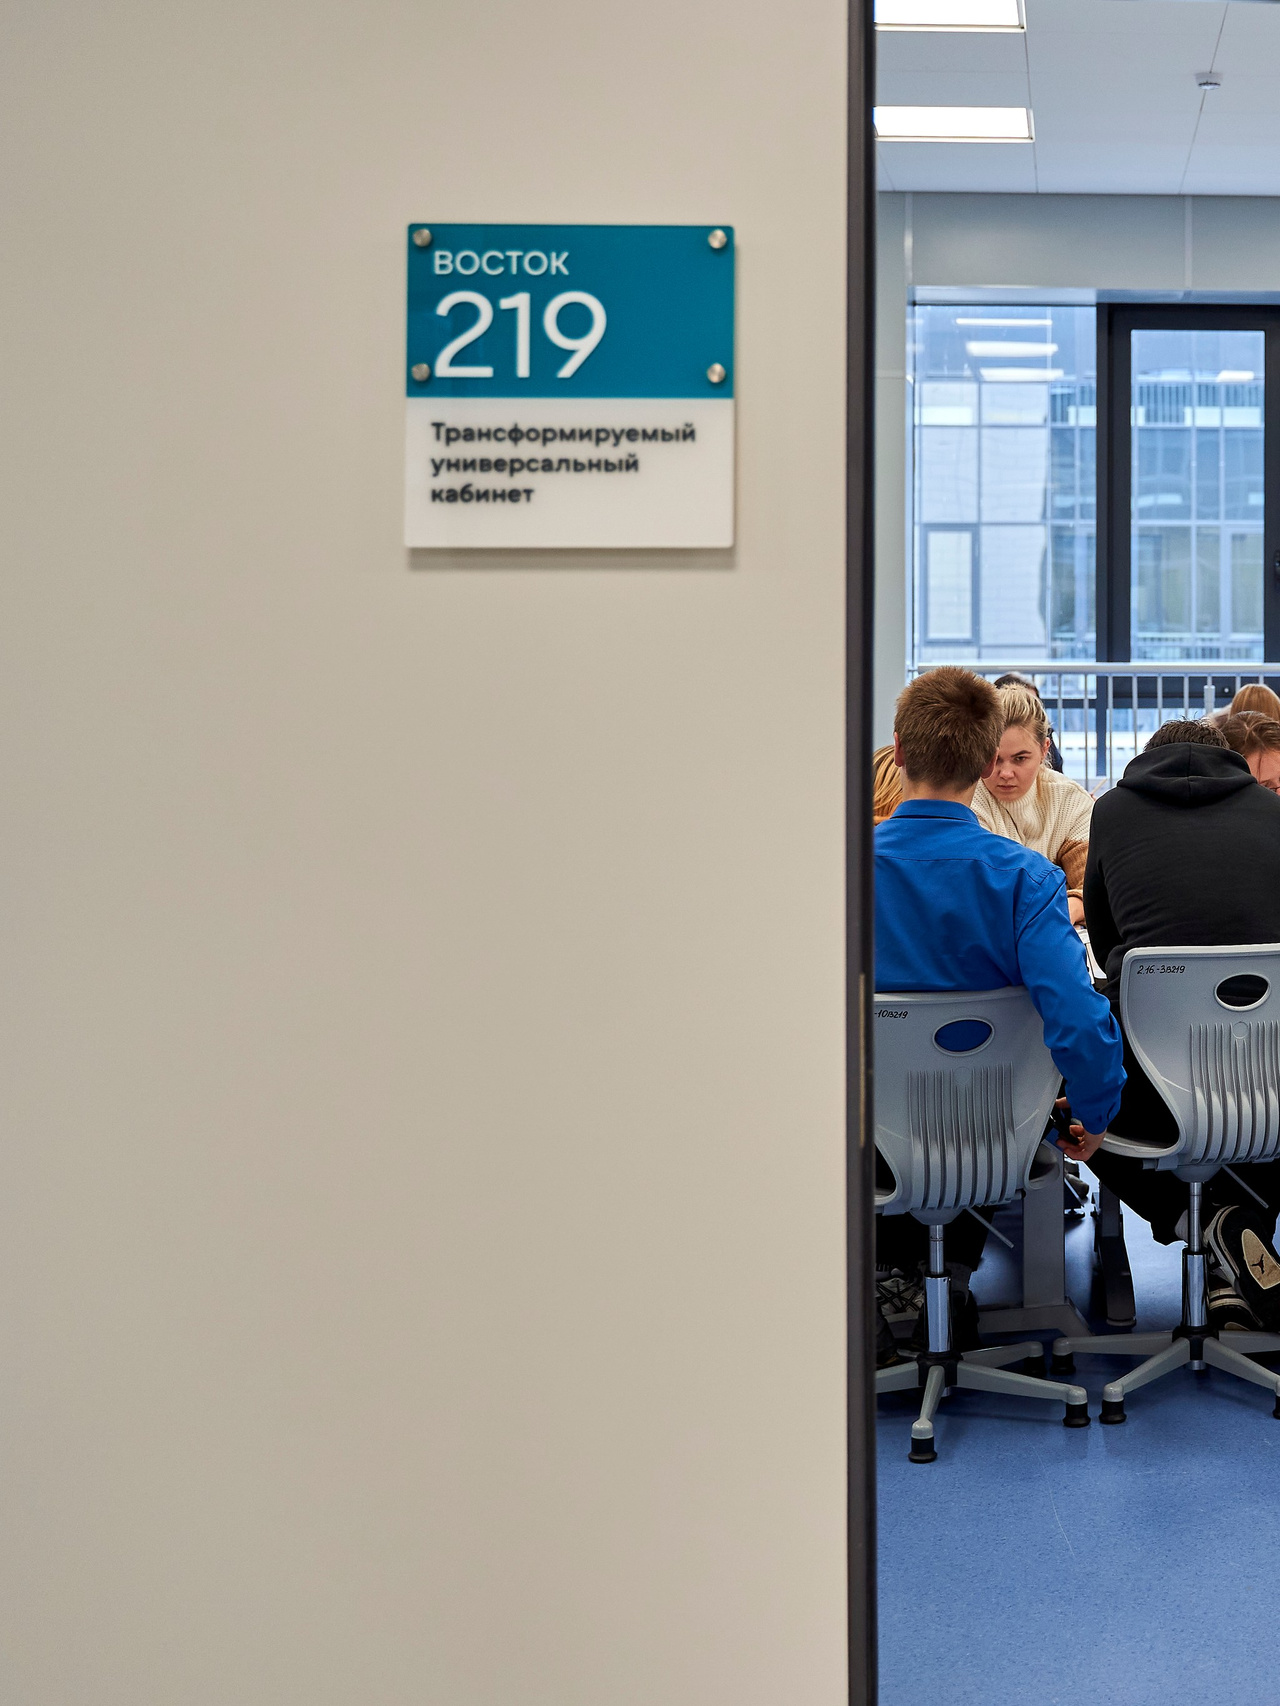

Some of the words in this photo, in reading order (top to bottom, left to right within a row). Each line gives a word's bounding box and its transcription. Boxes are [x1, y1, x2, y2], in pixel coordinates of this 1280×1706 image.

[433, 251, 570, 276] ВОСТОК
[434, 291, 607, 378] 219
[431, 422, 696, 447] Трансформируемый
[431, 454, 640, 477] универсальный
[431, 483, 535, 503] кабинет
